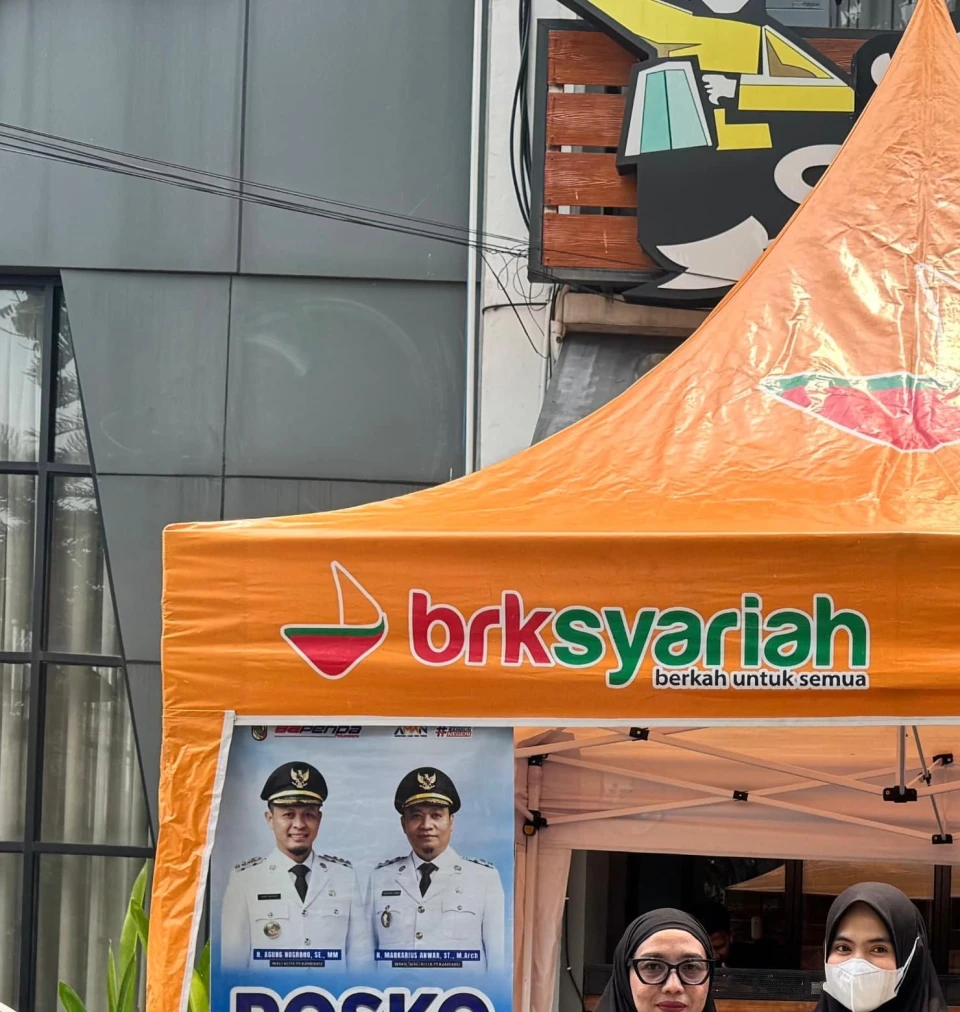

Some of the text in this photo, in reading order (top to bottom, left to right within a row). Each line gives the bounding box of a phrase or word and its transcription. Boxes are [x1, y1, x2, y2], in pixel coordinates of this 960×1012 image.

[409, 589, 870, 688] brksyariah
[655, 667, 867, 688] berkah untuk semua
